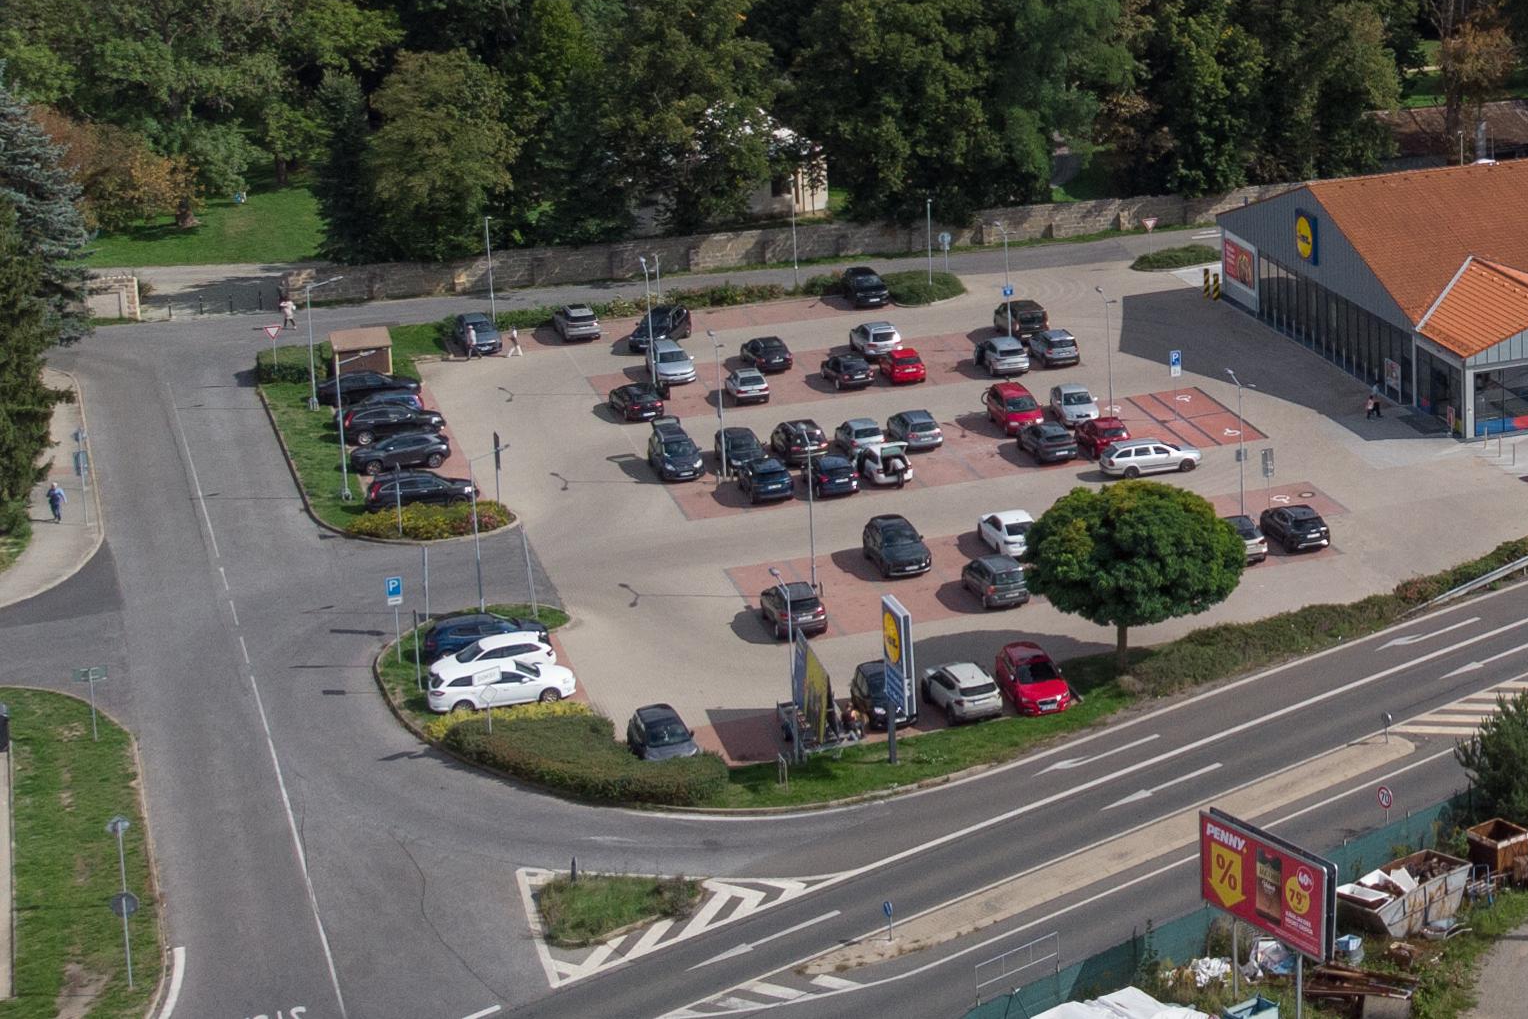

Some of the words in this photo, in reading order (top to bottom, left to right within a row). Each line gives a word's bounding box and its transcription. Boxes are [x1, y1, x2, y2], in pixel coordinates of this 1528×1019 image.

[1172, 352, 1179, 363] P
[388, 579, 399, 592] P
[1381, 791, 1390, 804] 70
[1216, 853, 1238, 891] %
